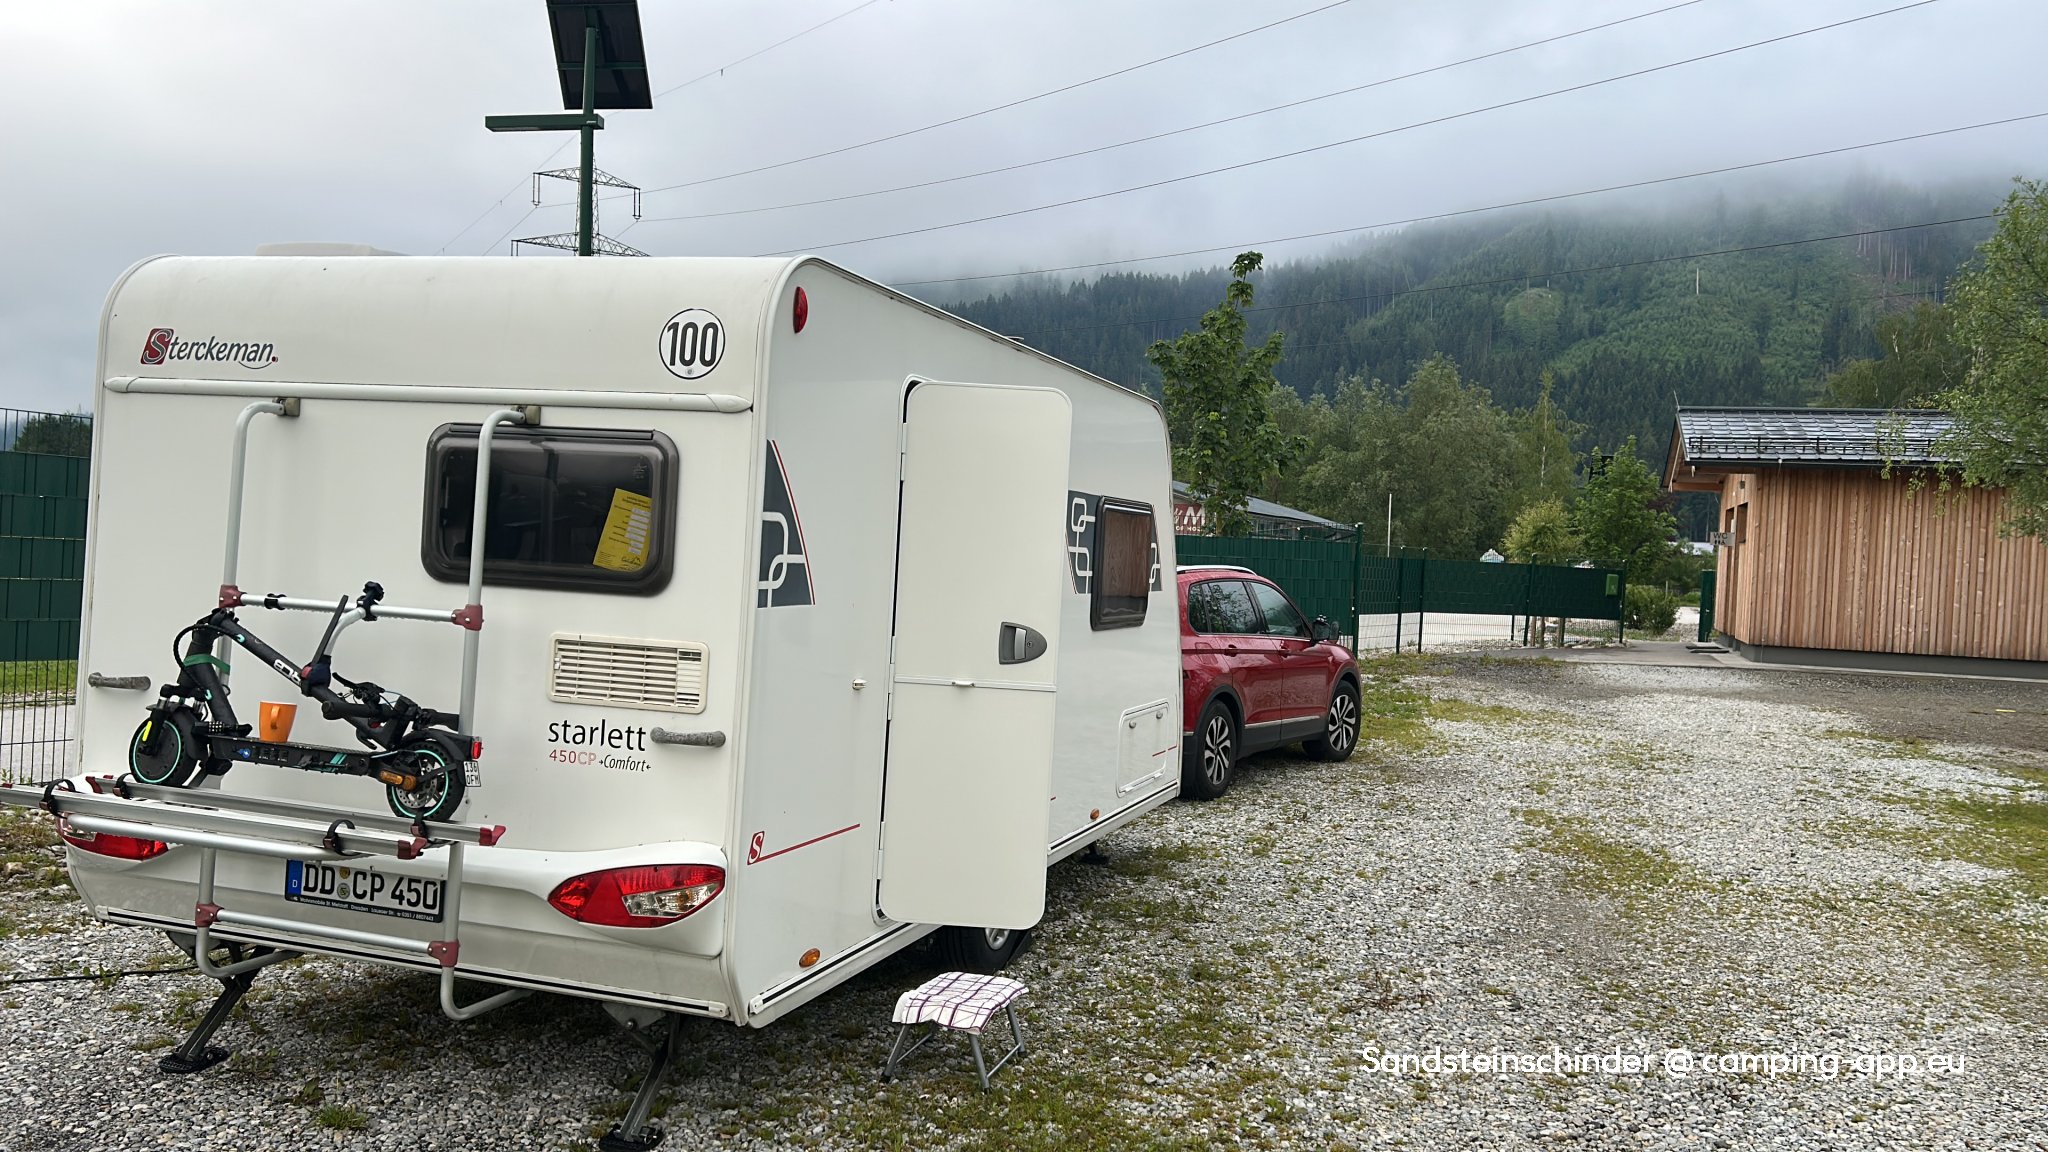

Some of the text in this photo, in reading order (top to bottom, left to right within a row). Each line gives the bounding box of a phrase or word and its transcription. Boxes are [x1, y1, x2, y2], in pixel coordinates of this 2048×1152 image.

[667, 321, 719, 367] 100
[1713, 532, 1728, 540] WC
[548, 719, 647, 751] starlett
[549, 749, 597, 766] 450CP
[292, 879, 298, 888] D
